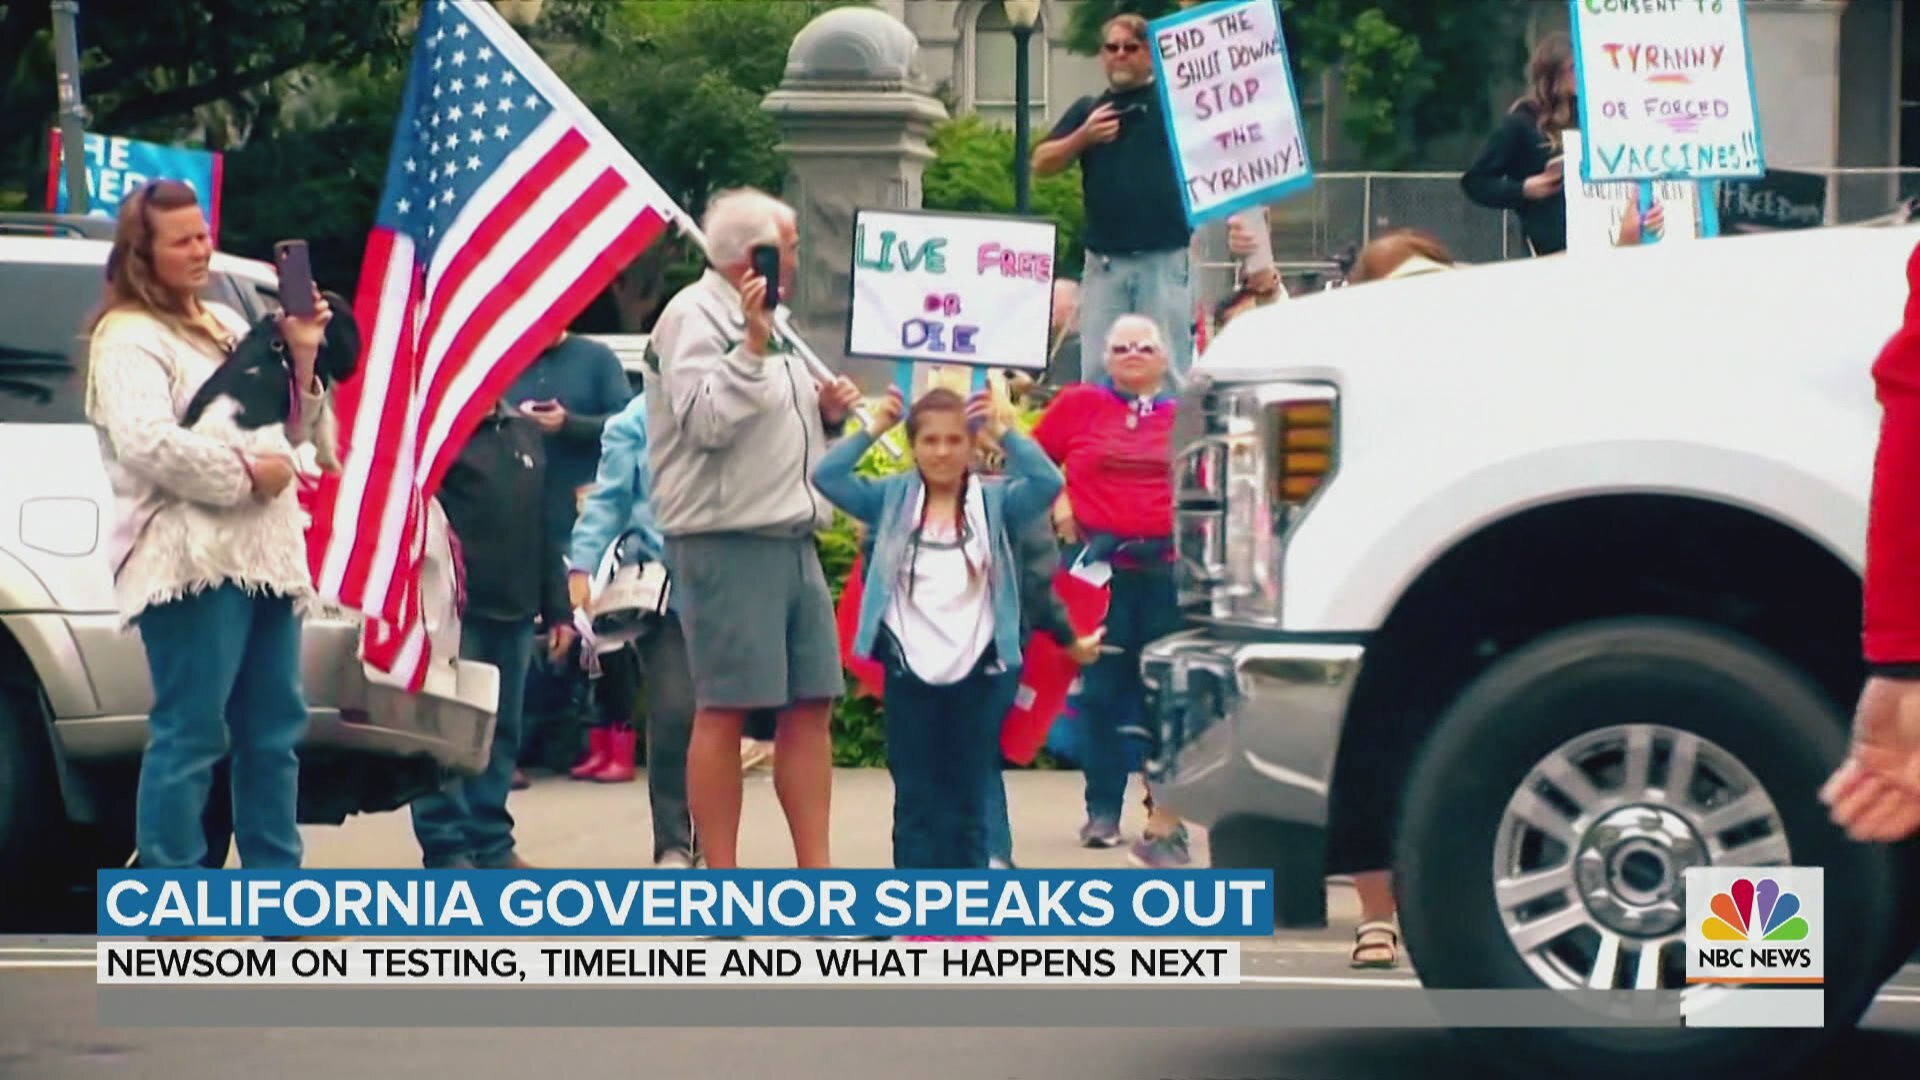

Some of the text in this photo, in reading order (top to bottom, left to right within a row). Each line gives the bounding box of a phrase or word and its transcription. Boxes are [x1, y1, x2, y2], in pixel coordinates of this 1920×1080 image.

[1158, 9, 1253, 59] END THE
[1176, 49, 1221, 89] SHUT
[1601, 43, 1726, 73] TYRANNY
[1195, 78, 1260, 119] STOP
[1602, 97, 1729, 120] OR FORCED
[84, 131, 130, 169] HE
[1214, 122, 1264, 150] THE
[1185, 136, 1304, 203] TYRANNY!
[857, 223, 1051, 284] LIVE FREE
[924, 293, 962, 317] OR
[902, 318, 980, 354] DIE
